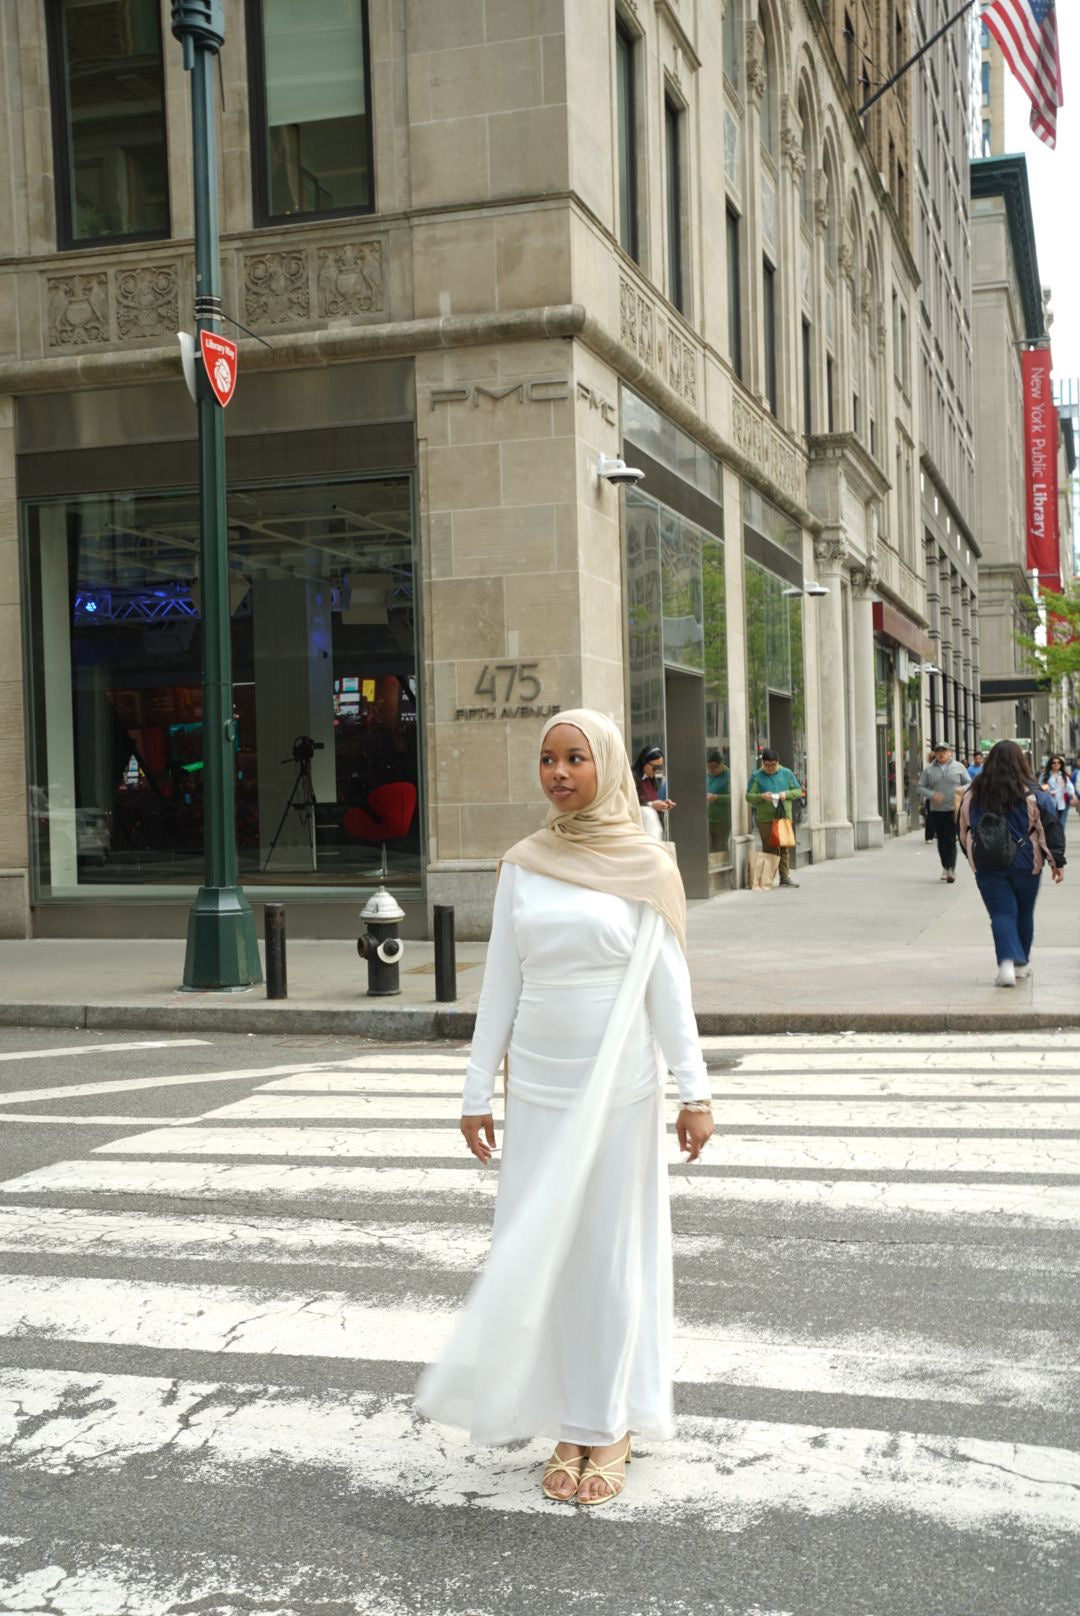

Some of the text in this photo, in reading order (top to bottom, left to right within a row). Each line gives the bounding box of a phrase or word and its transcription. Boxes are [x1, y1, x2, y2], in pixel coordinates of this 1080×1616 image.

[205, 338, 235, 360] Library Way
[431, 381, 569, 412] PMC
[1030, 367, 1048, 539] New York Public Library
[474, 663, 541, 702] 475
[456, 704, 560, 720] FIFTH AVENUE
